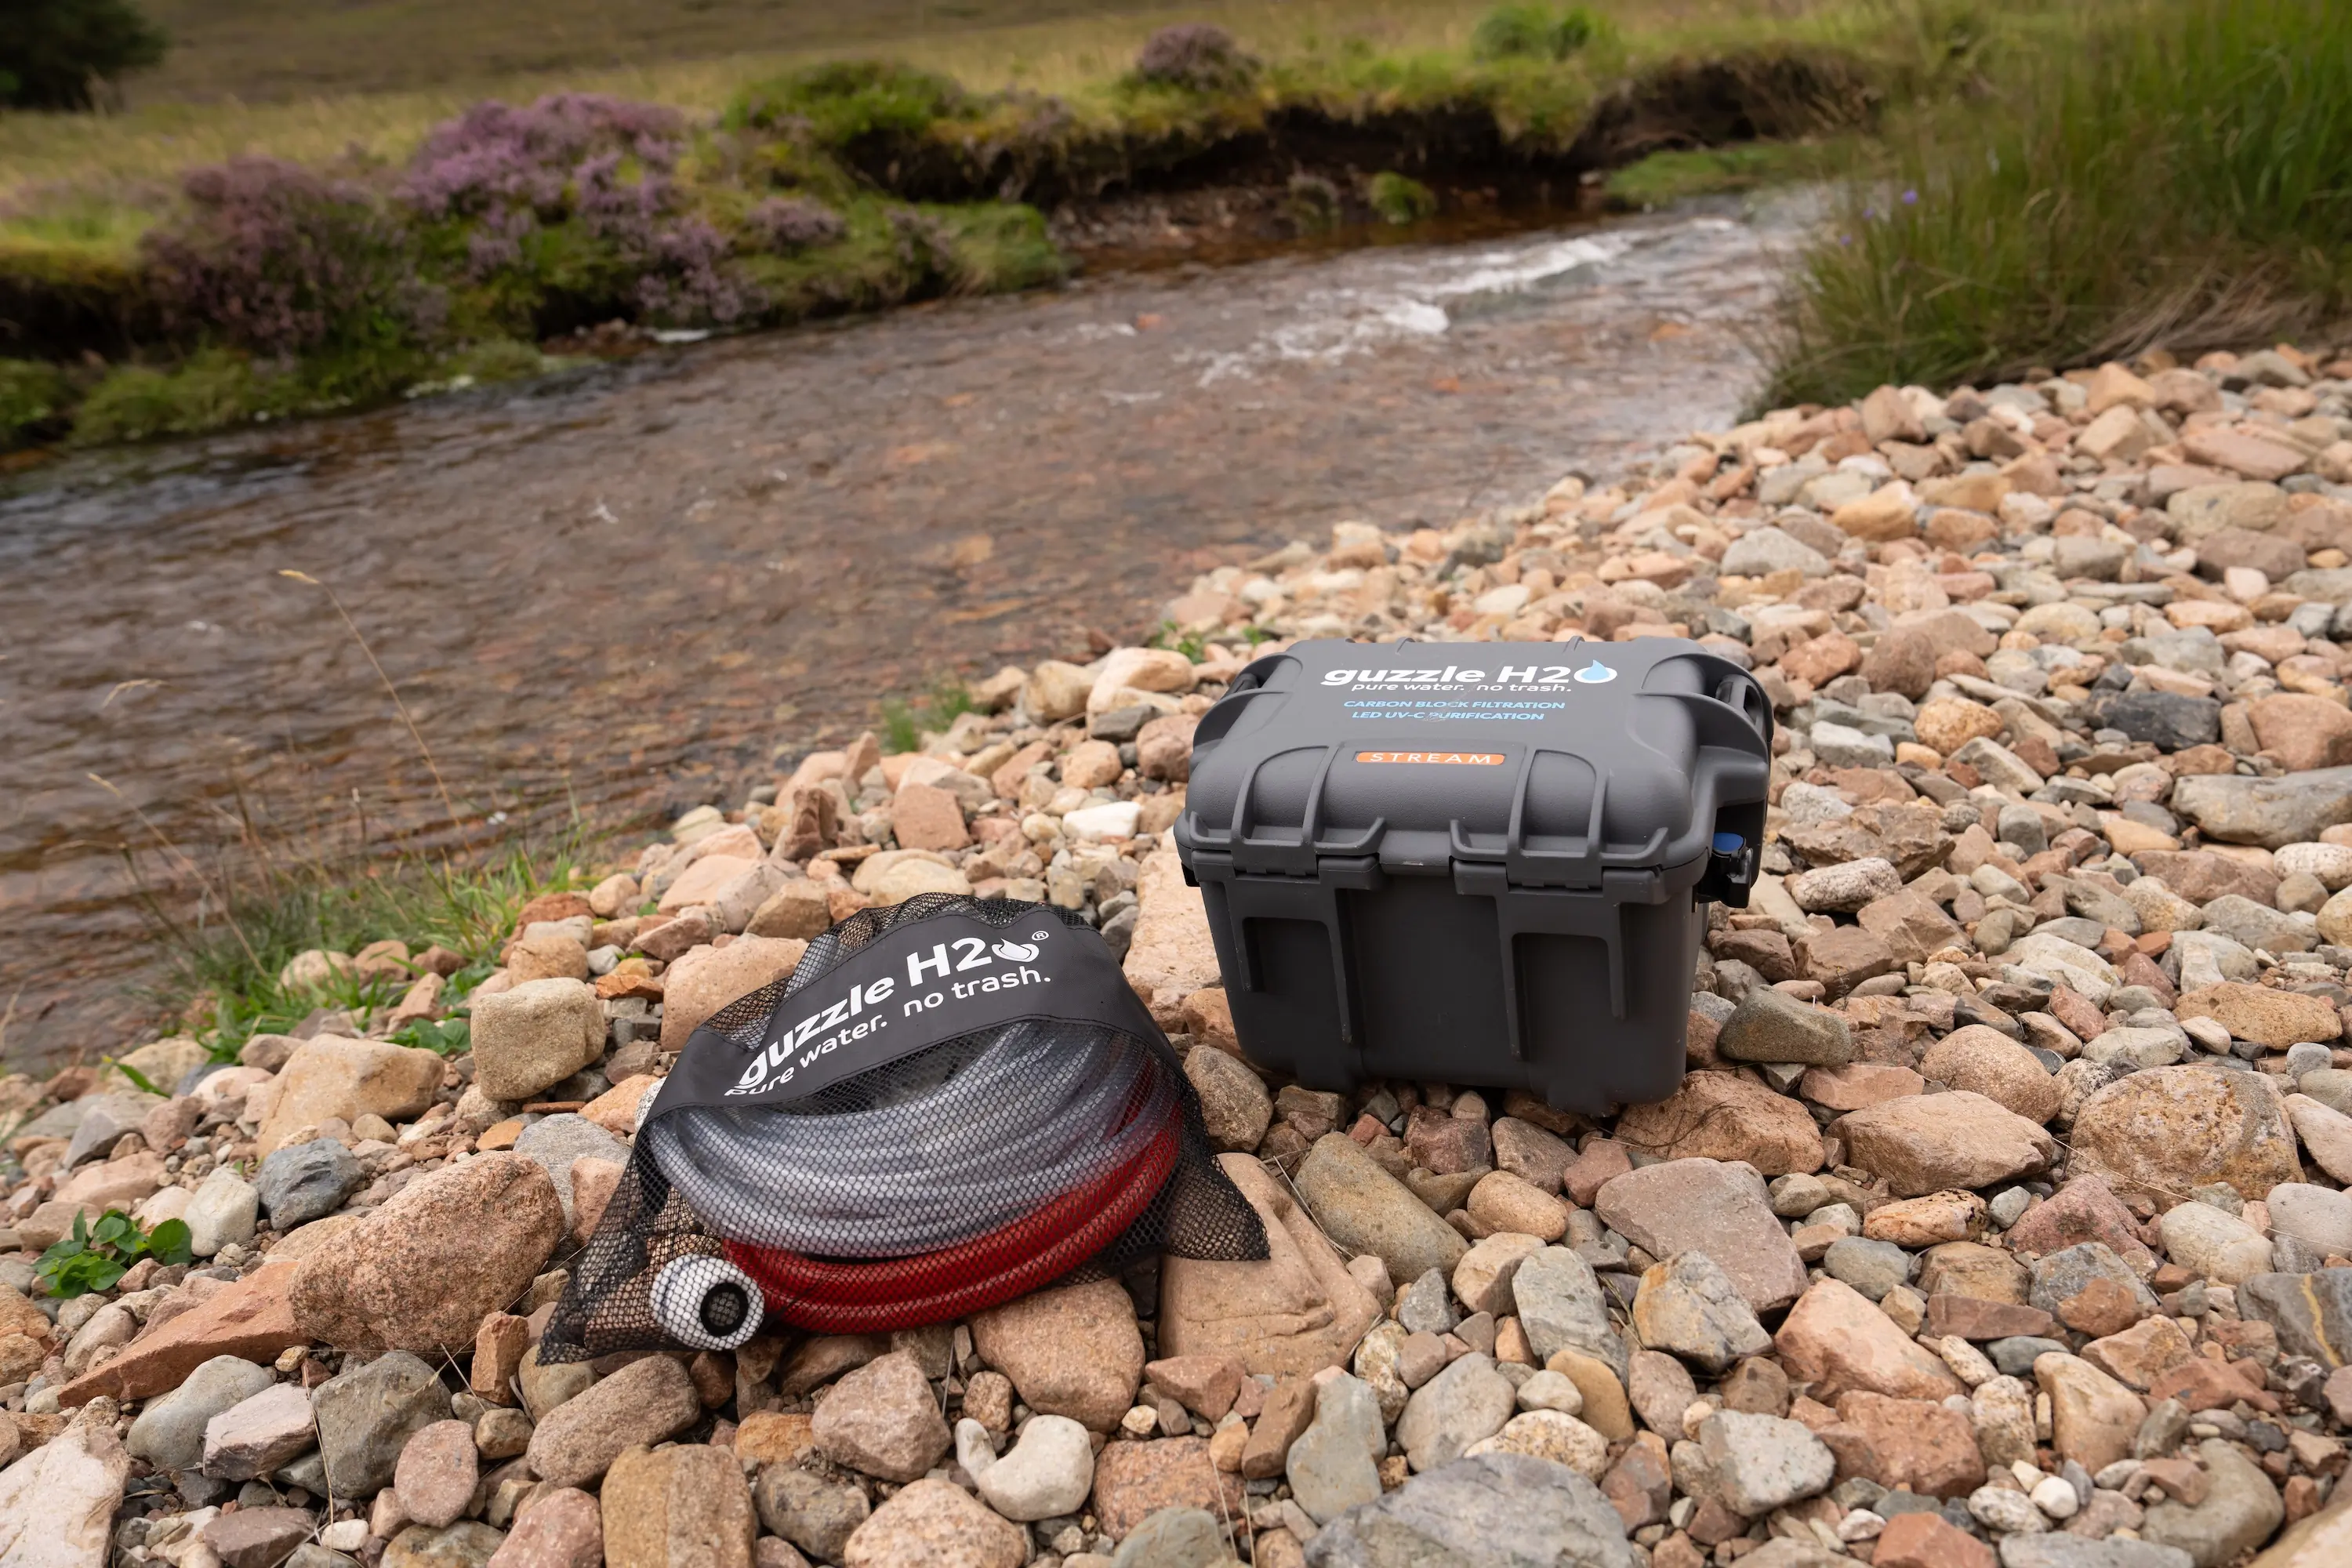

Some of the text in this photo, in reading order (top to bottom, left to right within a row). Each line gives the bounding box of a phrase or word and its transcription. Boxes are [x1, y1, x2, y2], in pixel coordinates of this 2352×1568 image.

[1320, 666, 1486, 686] guzzle
[1509, 684, 1572, 692] trash.
[1428, 712, 1544, 720] PURIFICATION
[1370, 752, 1491, 764] STREAM
[724, 965, 1051, 1097] pure water. no trash.
[735, 976, 894, 1089] guzzle
